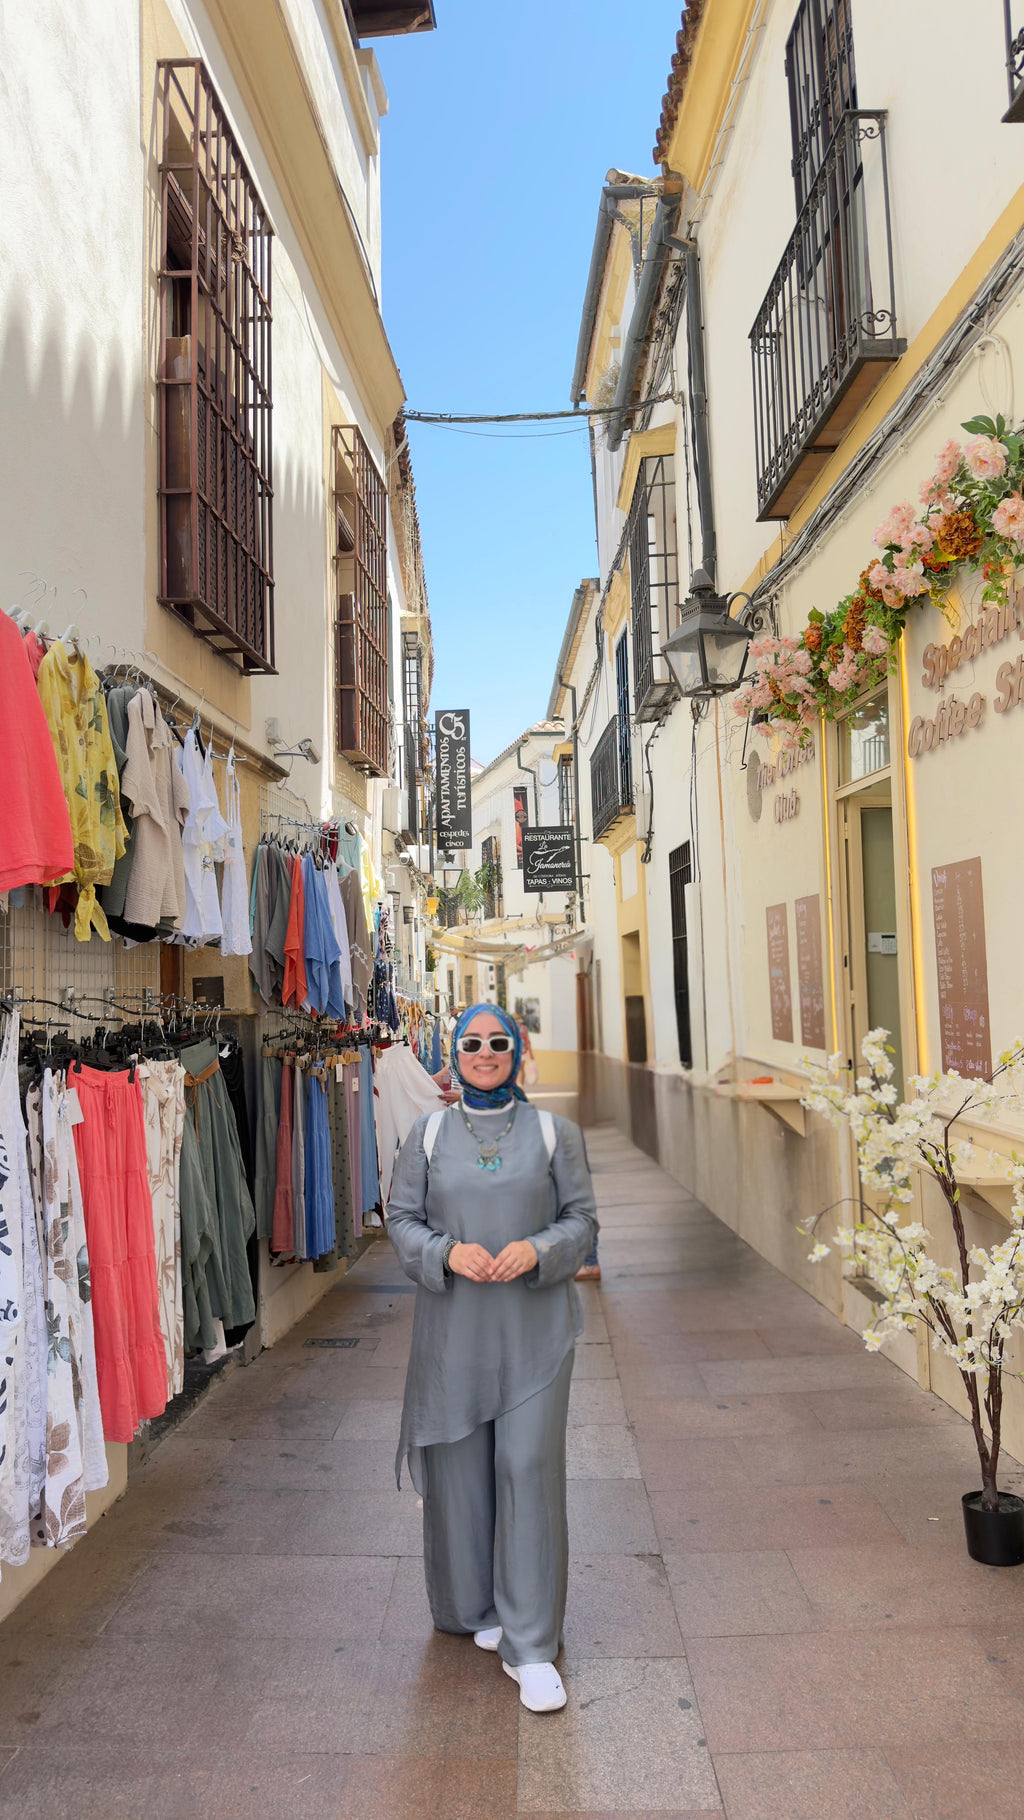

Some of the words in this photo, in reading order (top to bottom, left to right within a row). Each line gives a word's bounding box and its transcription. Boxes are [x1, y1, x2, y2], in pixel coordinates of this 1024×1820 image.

[921, 578, 1024, 693] Specialt
[908, 692, 984, 759] Coffee
[757, 762, 776, 792] The
[774, 787, 800, 824] Club
[524, 834, 571, 842] RESTAURANTE
